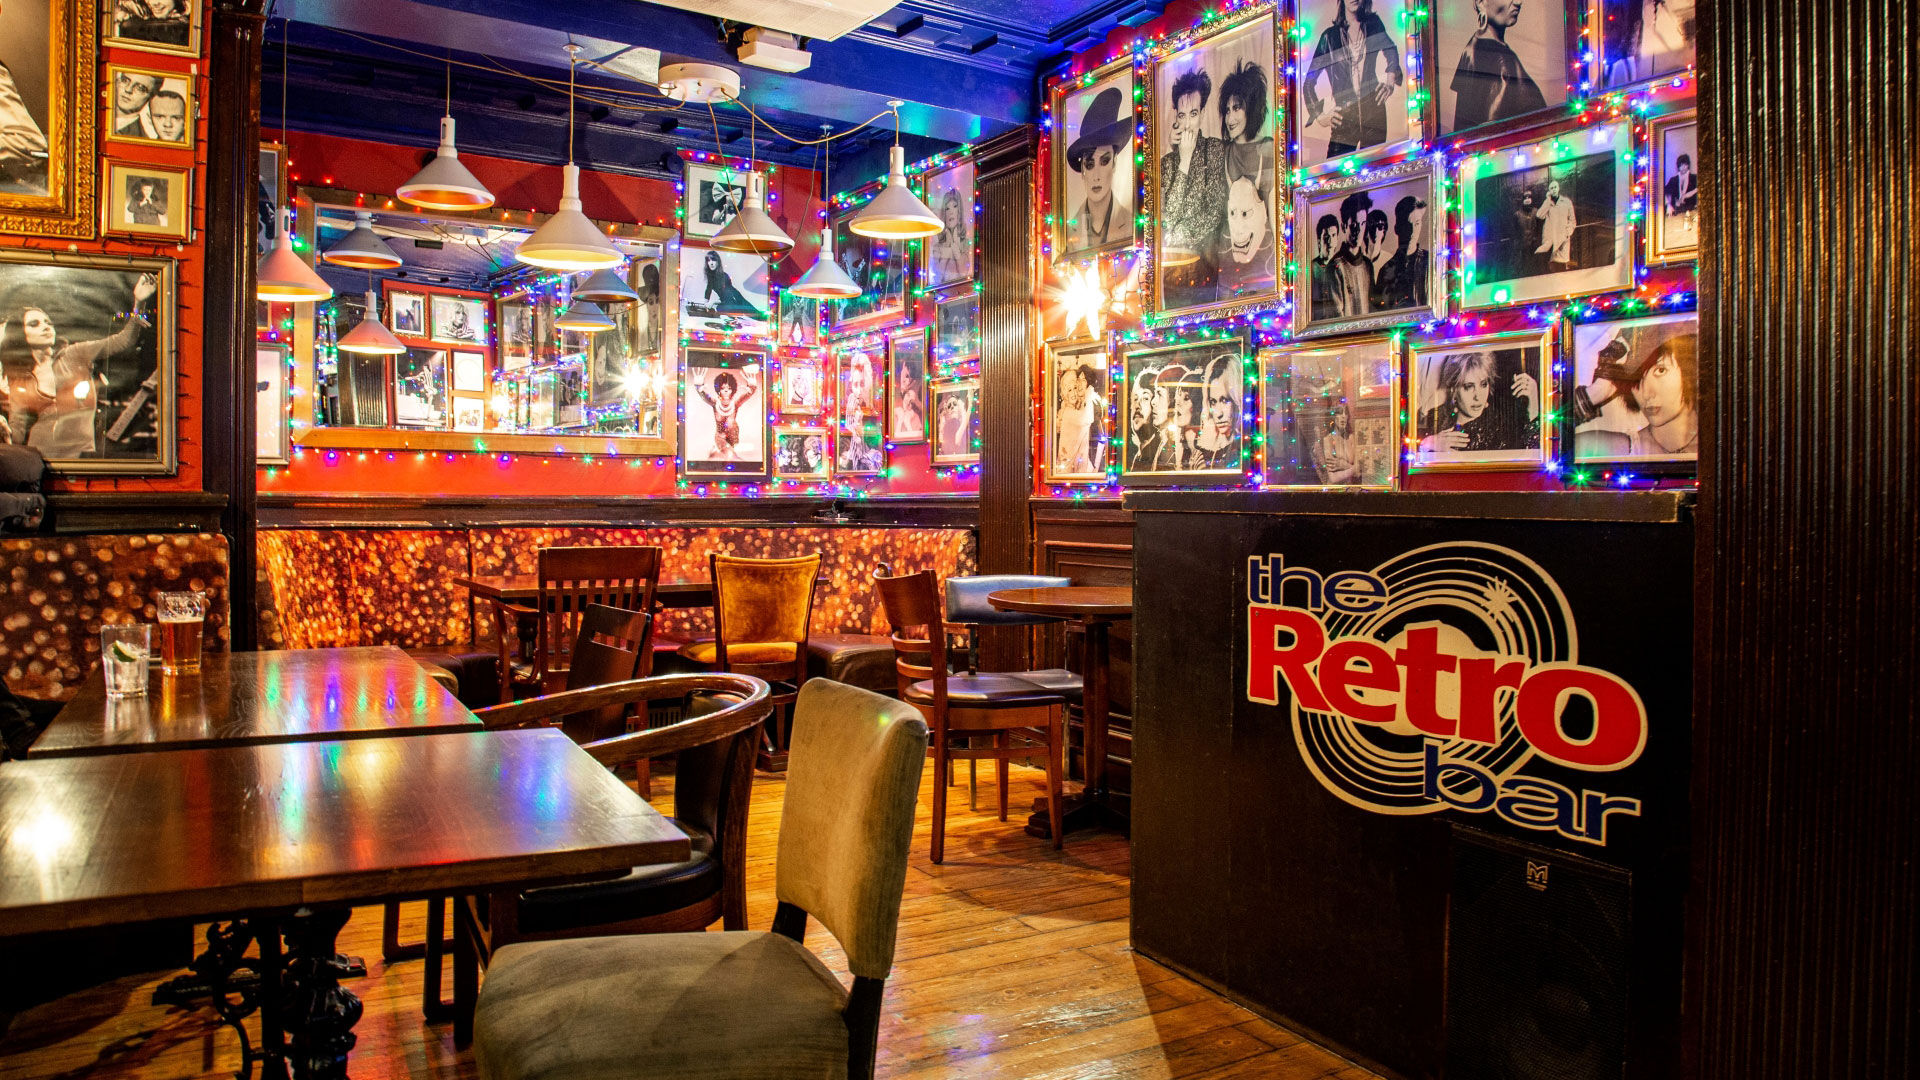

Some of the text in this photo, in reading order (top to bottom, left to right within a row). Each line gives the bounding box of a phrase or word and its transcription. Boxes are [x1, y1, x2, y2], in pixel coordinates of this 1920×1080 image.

[1248, 553, 1390, 615] the
[1248, 604, 1648, 772] Retro
[1423, 738, 1641, 847] bar
